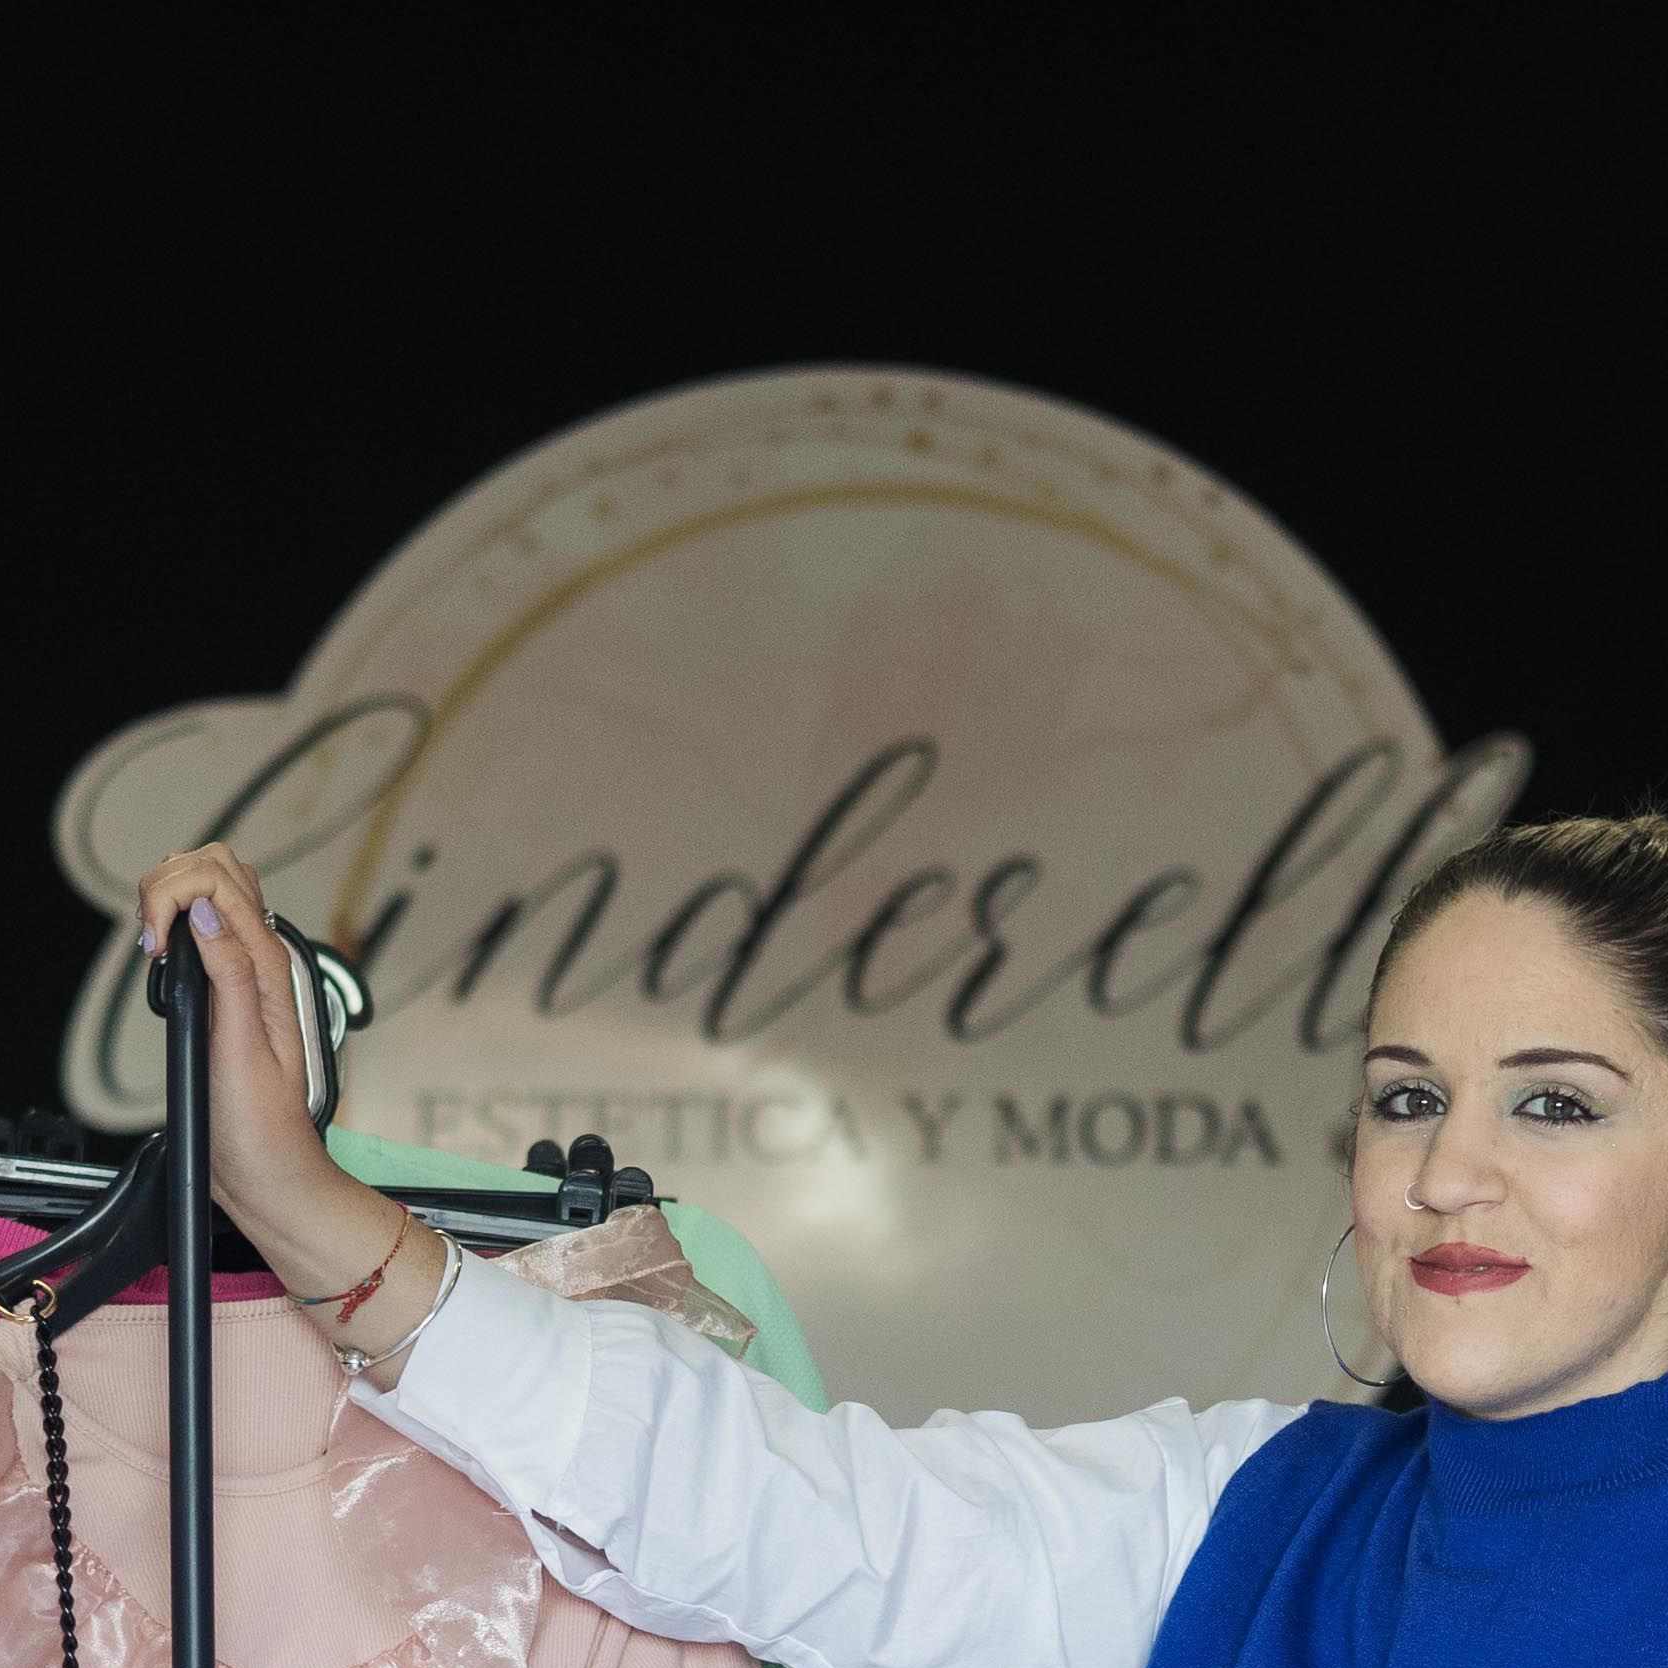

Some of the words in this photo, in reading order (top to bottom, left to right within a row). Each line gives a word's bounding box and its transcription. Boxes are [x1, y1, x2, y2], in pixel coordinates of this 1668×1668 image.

[75, 690, 1530, 1108] Cinderell
[898, 1090, 968, 1166] Y
[989, 1090, 1287, 1169] MODA
